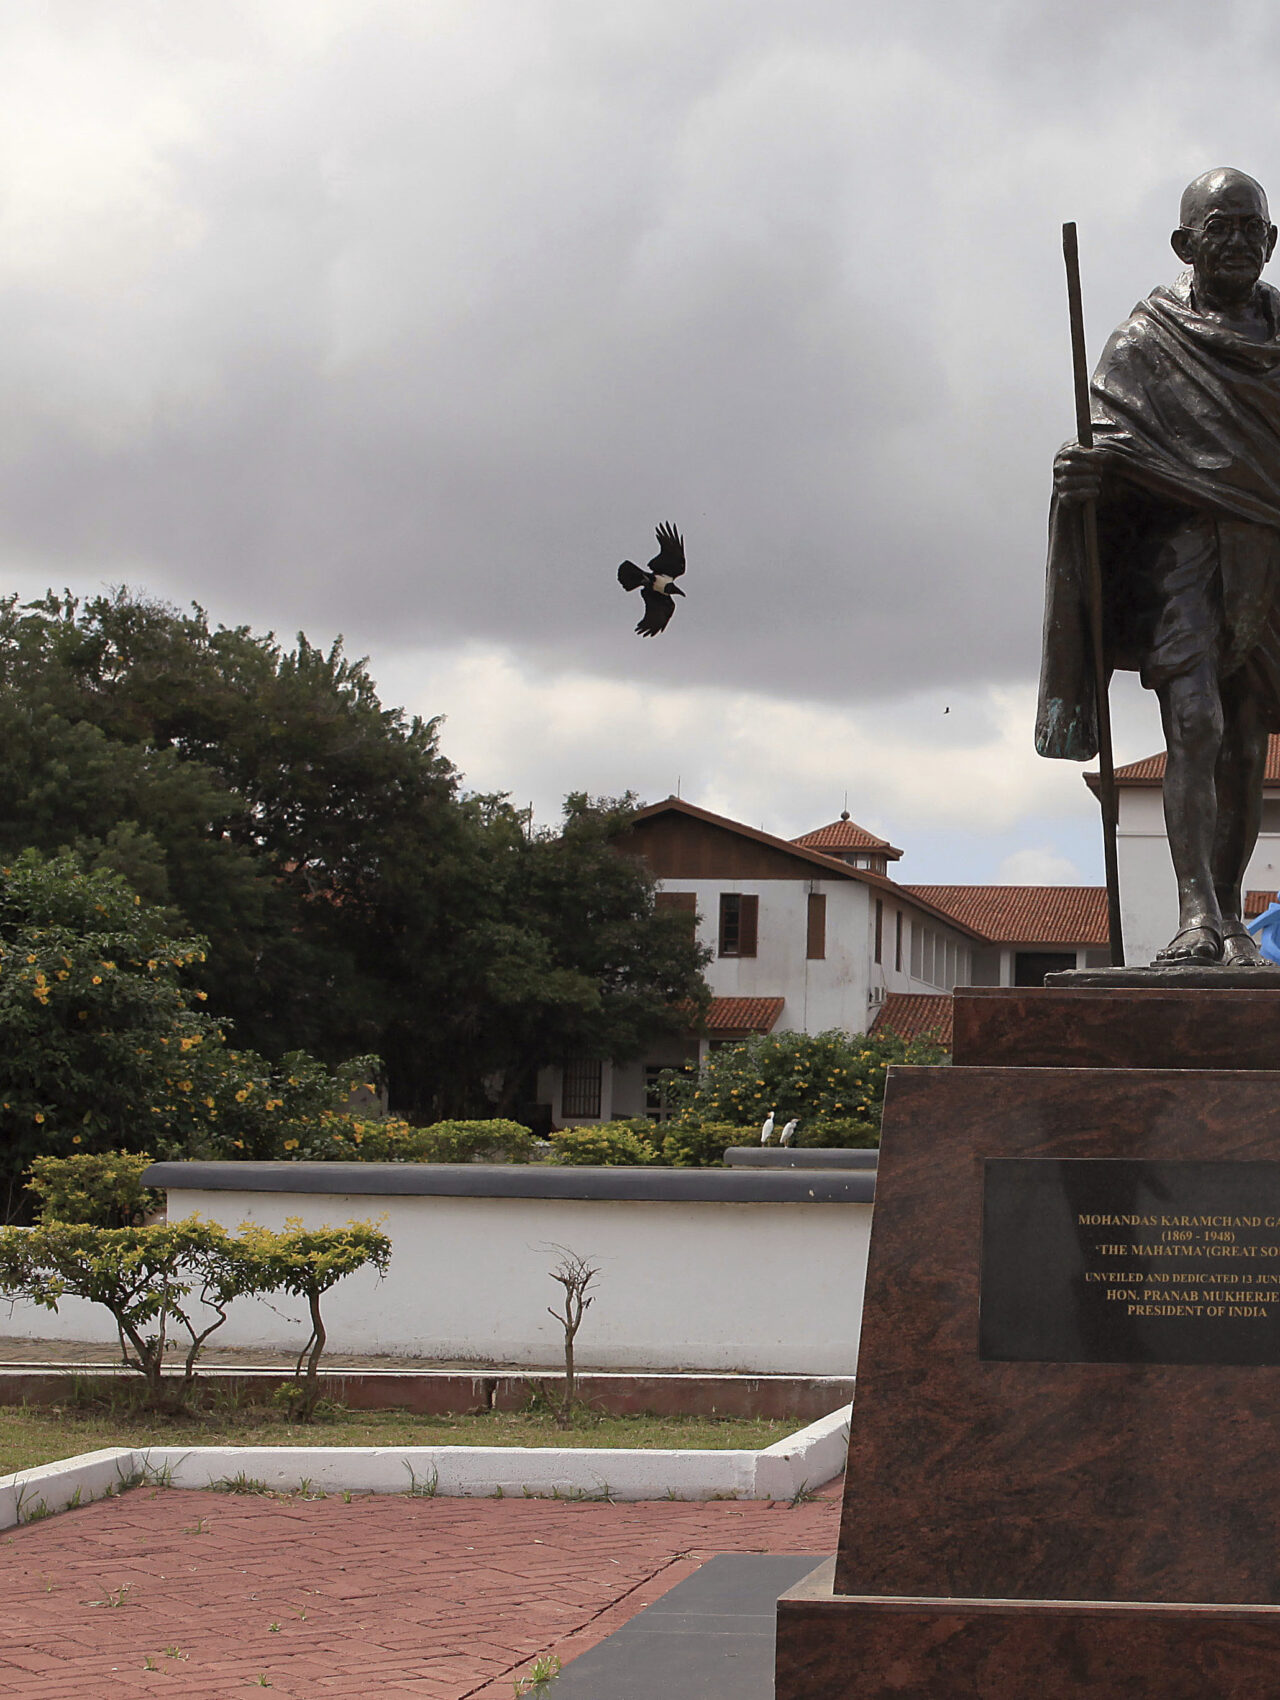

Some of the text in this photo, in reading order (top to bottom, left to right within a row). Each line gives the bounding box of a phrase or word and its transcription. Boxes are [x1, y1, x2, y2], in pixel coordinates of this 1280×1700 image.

[1078, 1214, 1158, 1226] MOHANDAS
[1161, 1215, 1261, 1227] KARAMCHAND
[1161, 1231, 1193, 1242] (1869
[1204, 1231, 1235, 1243] 1948)
[1085, 1272, 1143, 1282] UNVEILED
[1145, 1273, 1170, 1283] AND
[1172, 1273, 1238, 1284] DEDICATED
[1242, 1274, 1253, 1284] 13
[1106, 1289, 1140, 1301] HON.
[1143, 1290, 1199, 1302] PRANAB
[1127, 1305, 1268, 1318] PRESIDENT OF INDIA
